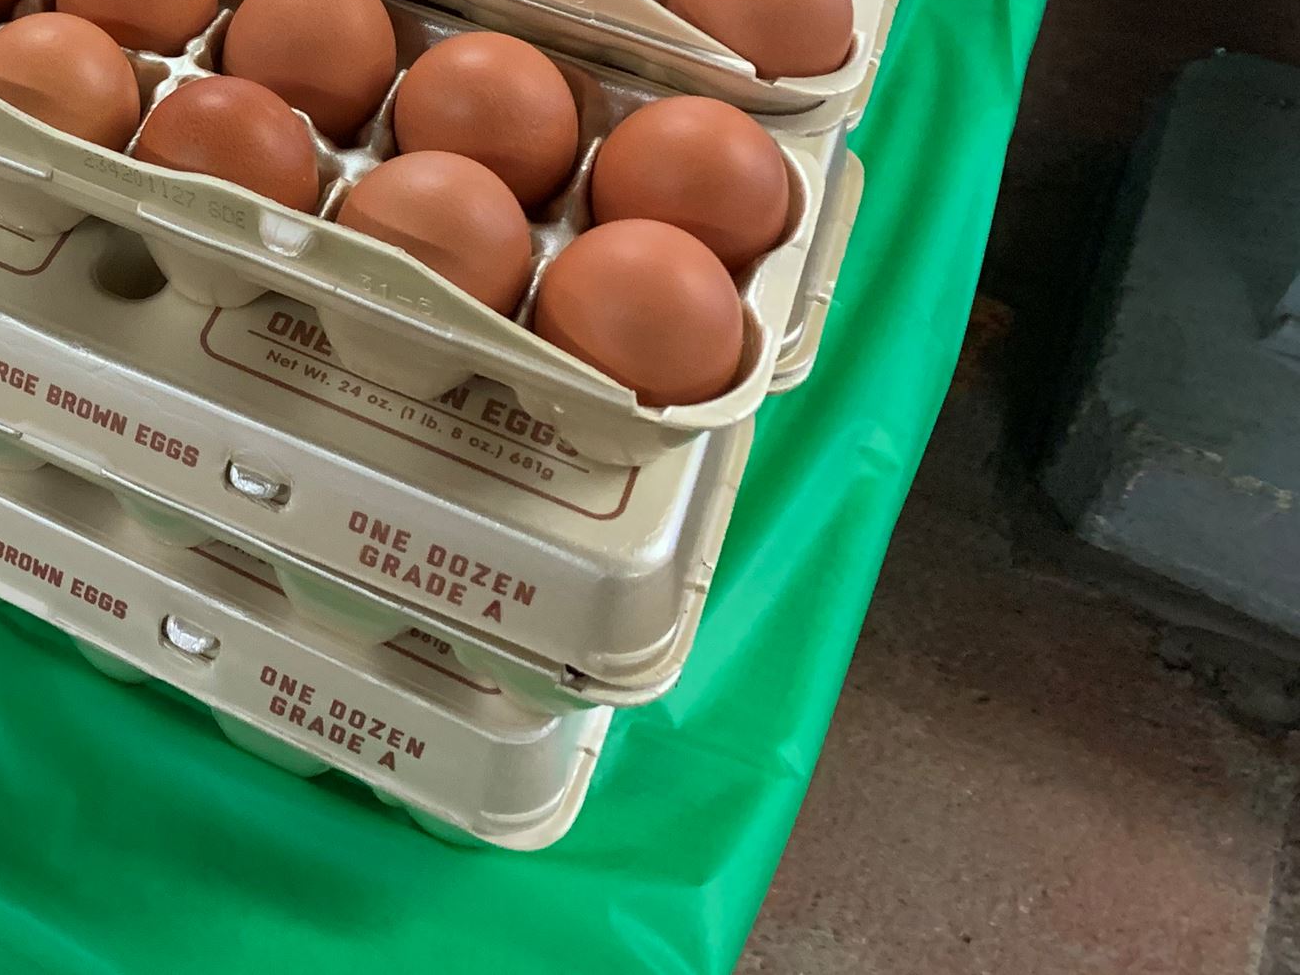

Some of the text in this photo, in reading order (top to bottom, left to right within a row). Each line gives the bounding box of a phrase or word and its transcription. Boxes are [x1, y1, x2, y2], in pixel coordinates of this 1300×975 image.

[266, 311, 333, 358] ONE
[46, 383, 129, 437] BROWN
[134, 422, 201, 469] EGGS
[266, 348, 299, 372] Net
[302, 362, 331, 387] Wt.
[337, 379, 362, 398] 24
[367, 392, 393, 413] oz.
[399, 398, 416, 421] (1
[419, 410, 443, 434] lb.
[451, 427, 463, 440] 8
[468, 434, 505, 460] oz.)
[508, 451, 555, 482] 681g
[70, 577, 130, 621] EGGS
[349, 510, 538, 607] ONE DOZEN
[359, 544, 503, 624] GRADE A
[260, 665, 427, 760] ONE DOZEN
[269, 695, 397, 772] GRADE A
